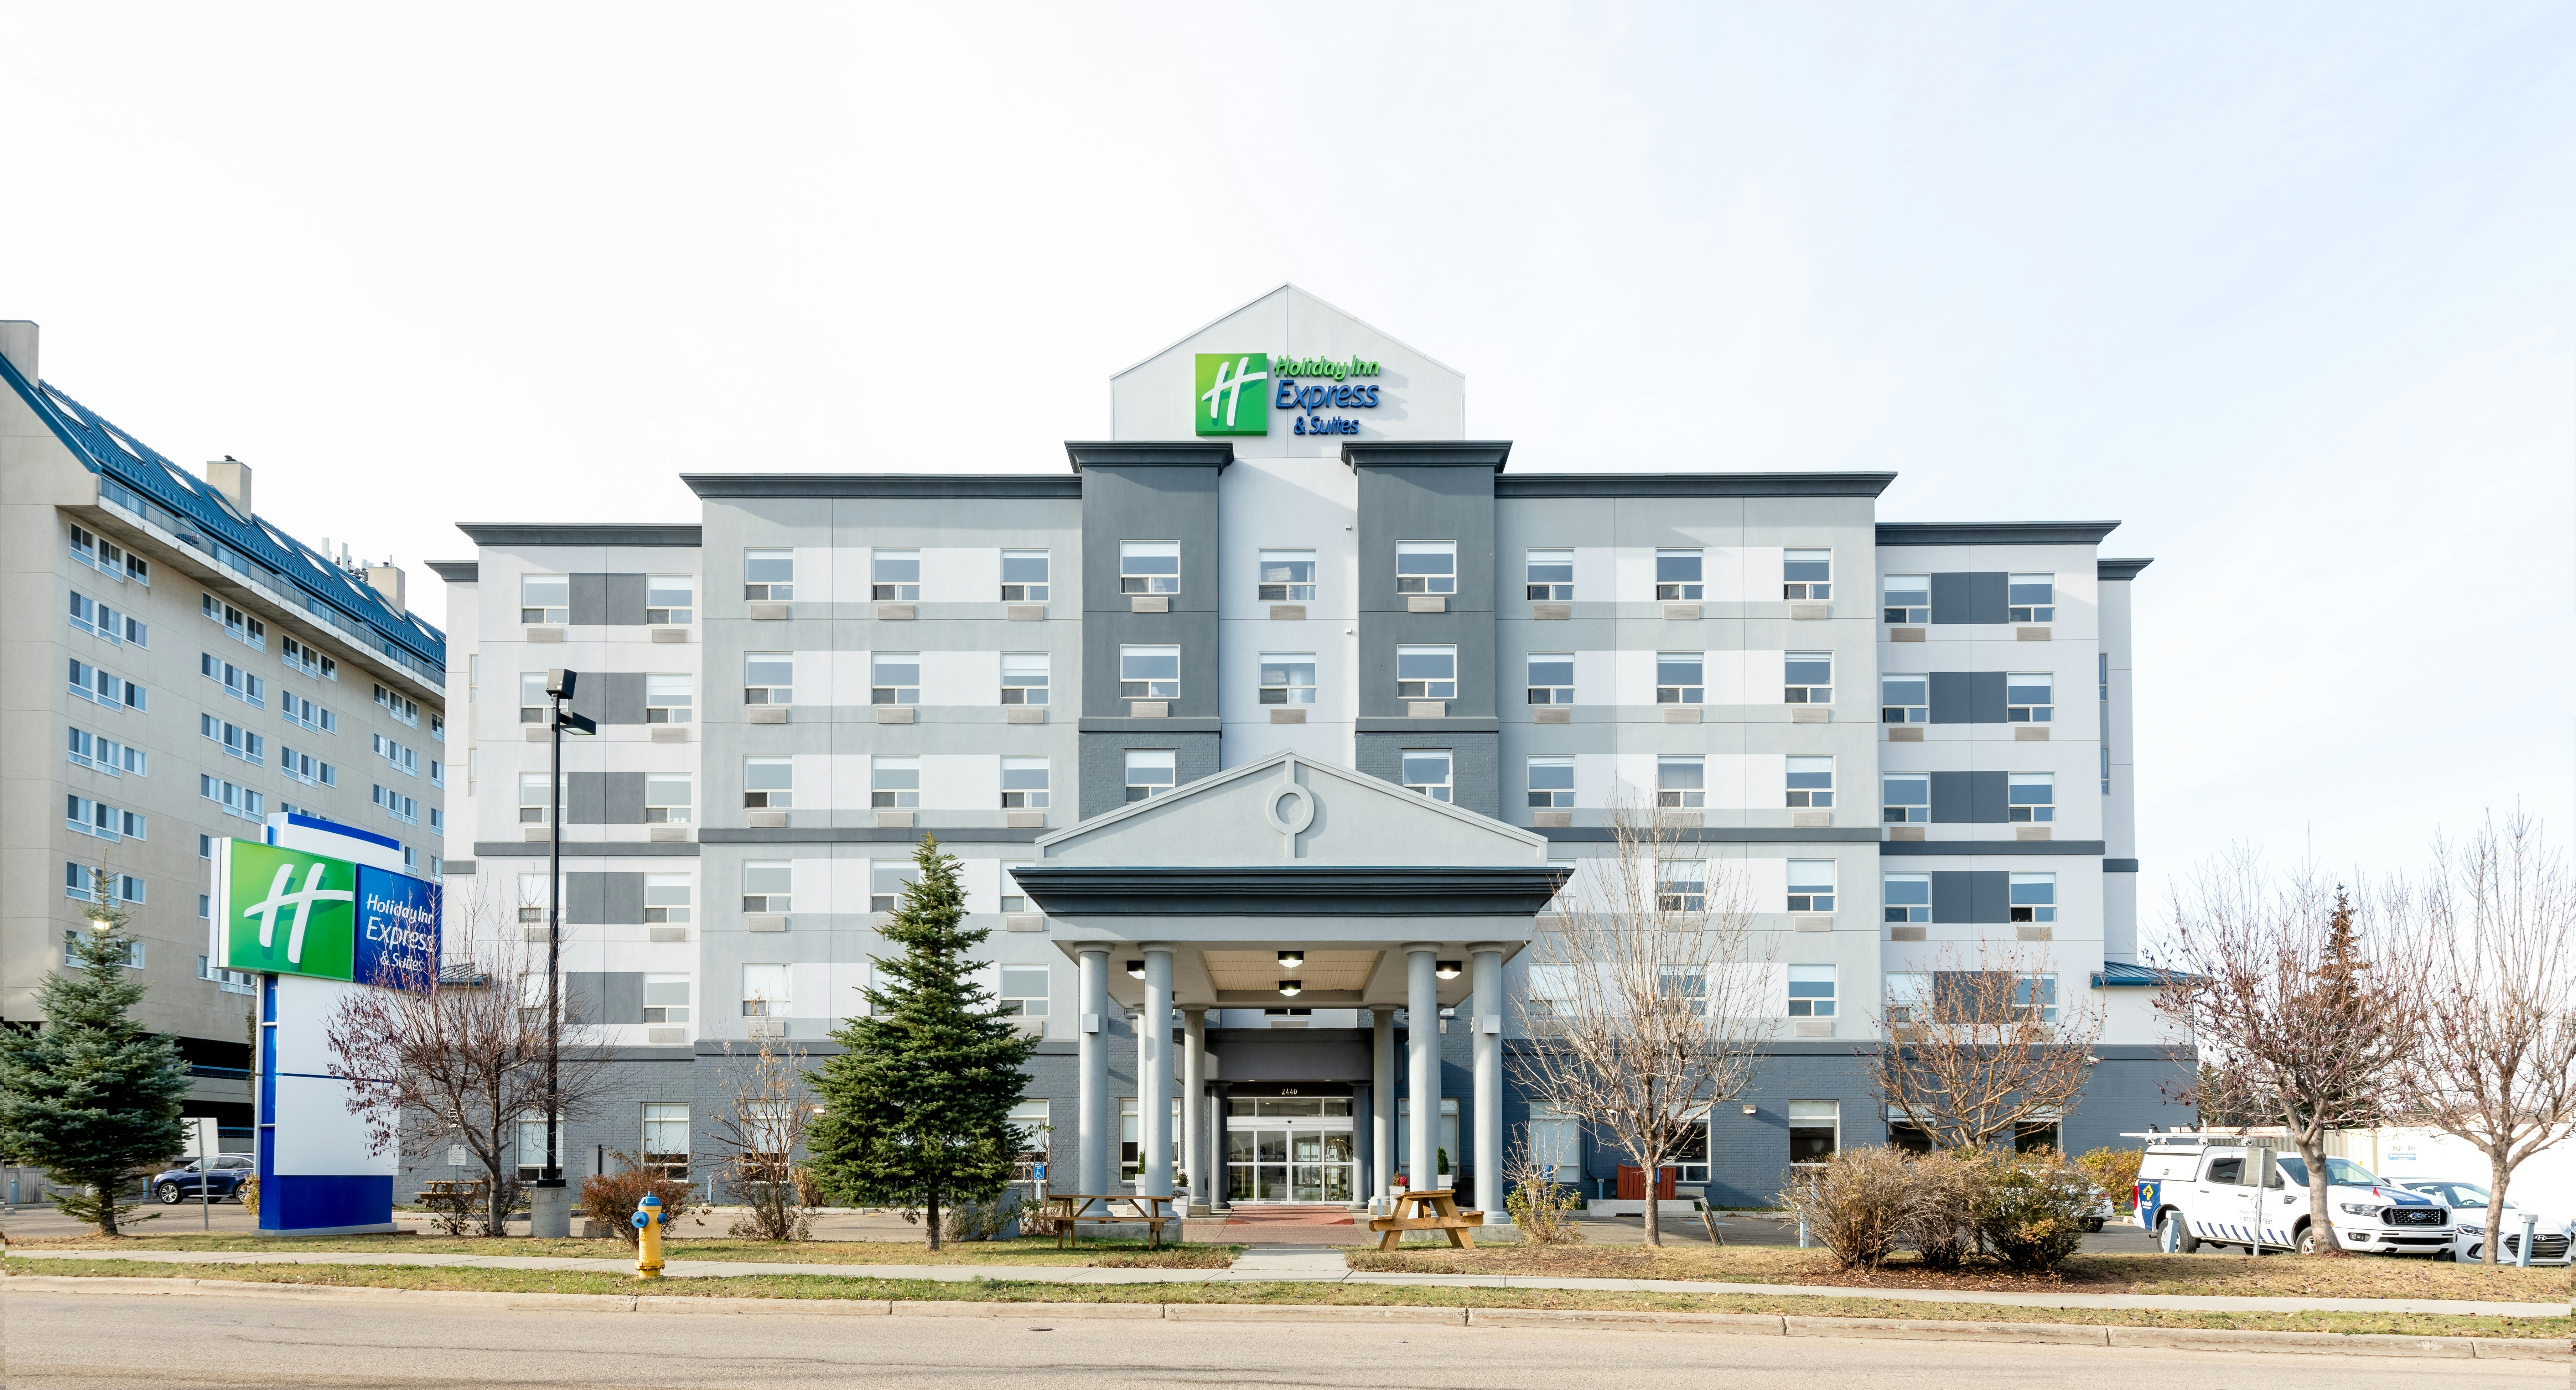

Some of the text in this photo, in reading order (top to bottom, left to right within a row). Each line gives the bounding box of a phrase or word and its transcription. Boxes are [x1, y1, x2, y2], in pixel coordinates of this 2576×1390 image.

[1274, 355, 1379, 381] Holiday Inn
[1276, 380, 1379, 416] Express
[1294, 416, 1359, 435] & Suites
[366, 893, 417, 924] Holiday
[366, 916, 433, 952] Express
[381, 951, 389, 966] &
